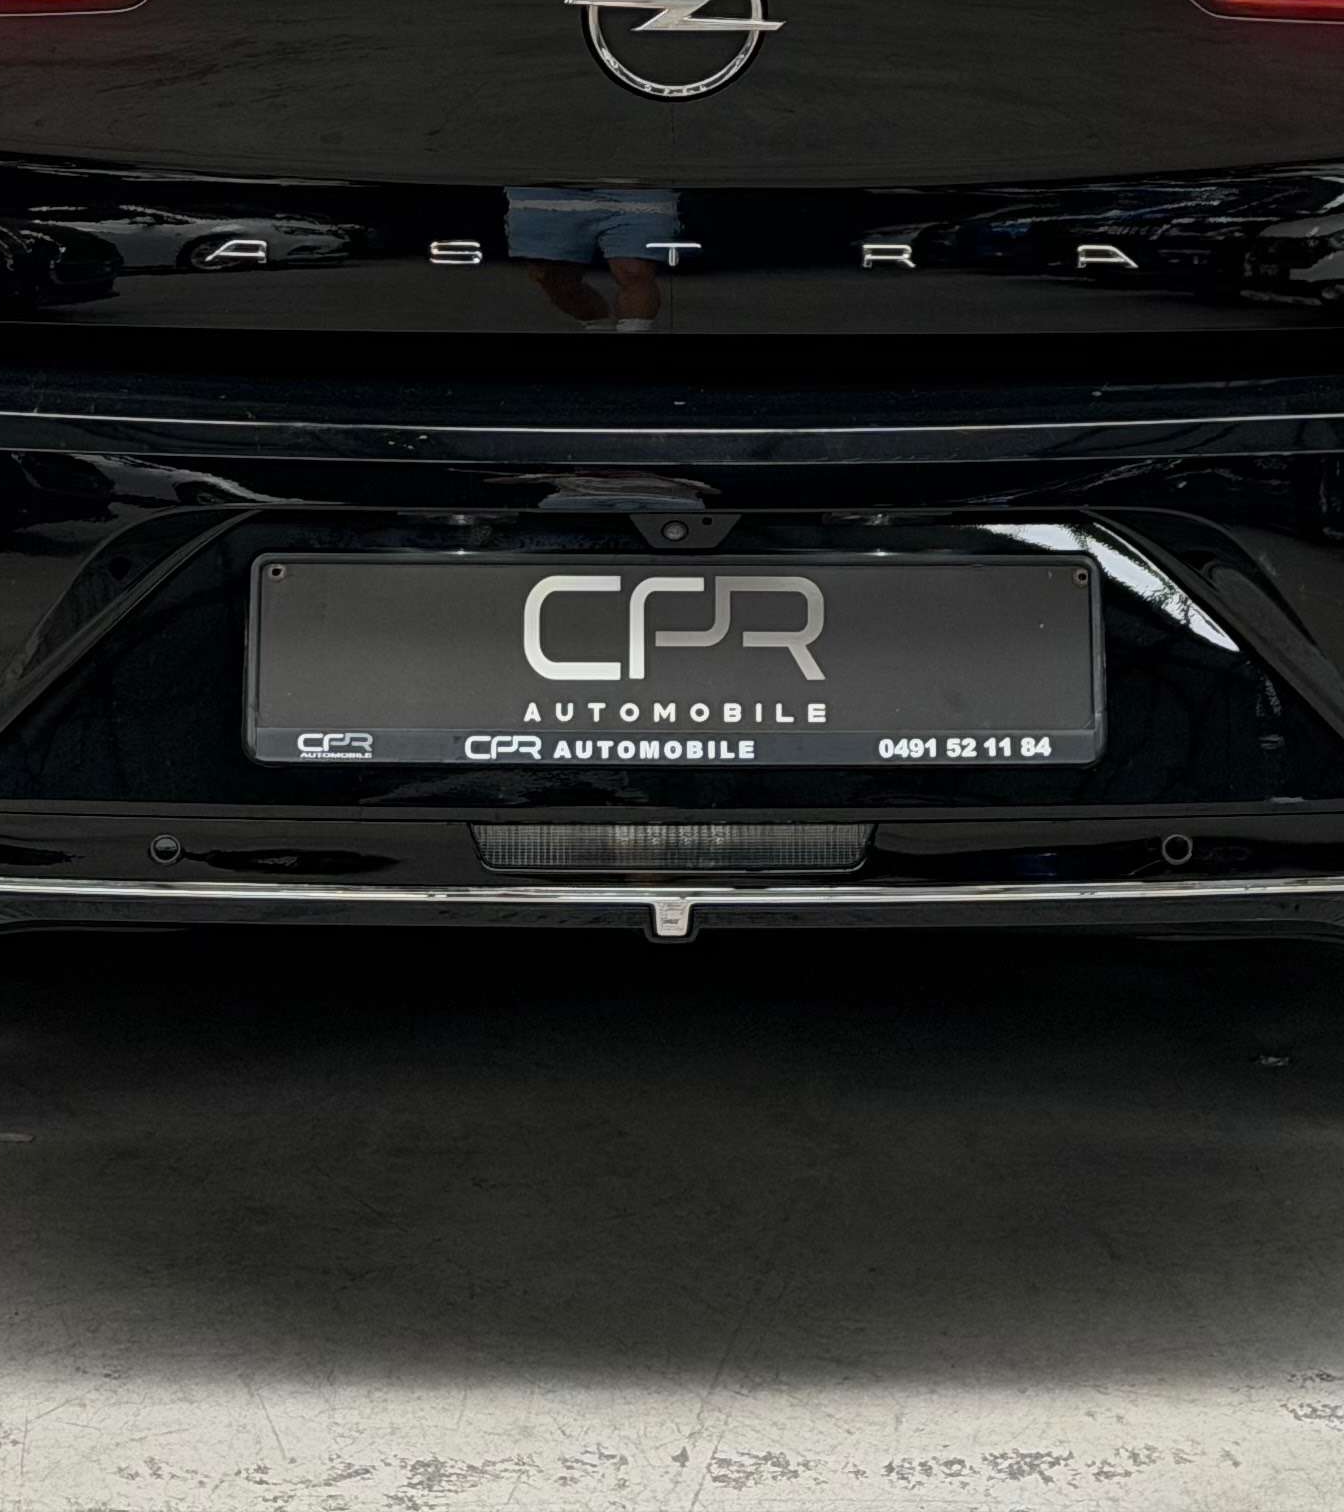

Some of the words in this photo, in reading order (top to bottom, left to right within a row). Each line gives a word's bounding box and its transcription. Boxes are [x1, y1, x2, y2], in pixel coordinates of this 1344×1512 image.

[206, 240, 1137, 267] ASTRA
[524, 575, 826, 680] CPR
[523, 702, 827, 723] AUTOMOBILE
[297, 732, 373, 751] CPR
[465, 735, 543, 760] CPR
[553, 740, 755, 760] AUTOMOBILE
[879, 738, 937, 759] 0491
[947, 738, 977, 759] 52
[984, 737, 1012, 758] 11
[1021, 737, 1052, 758] 84
